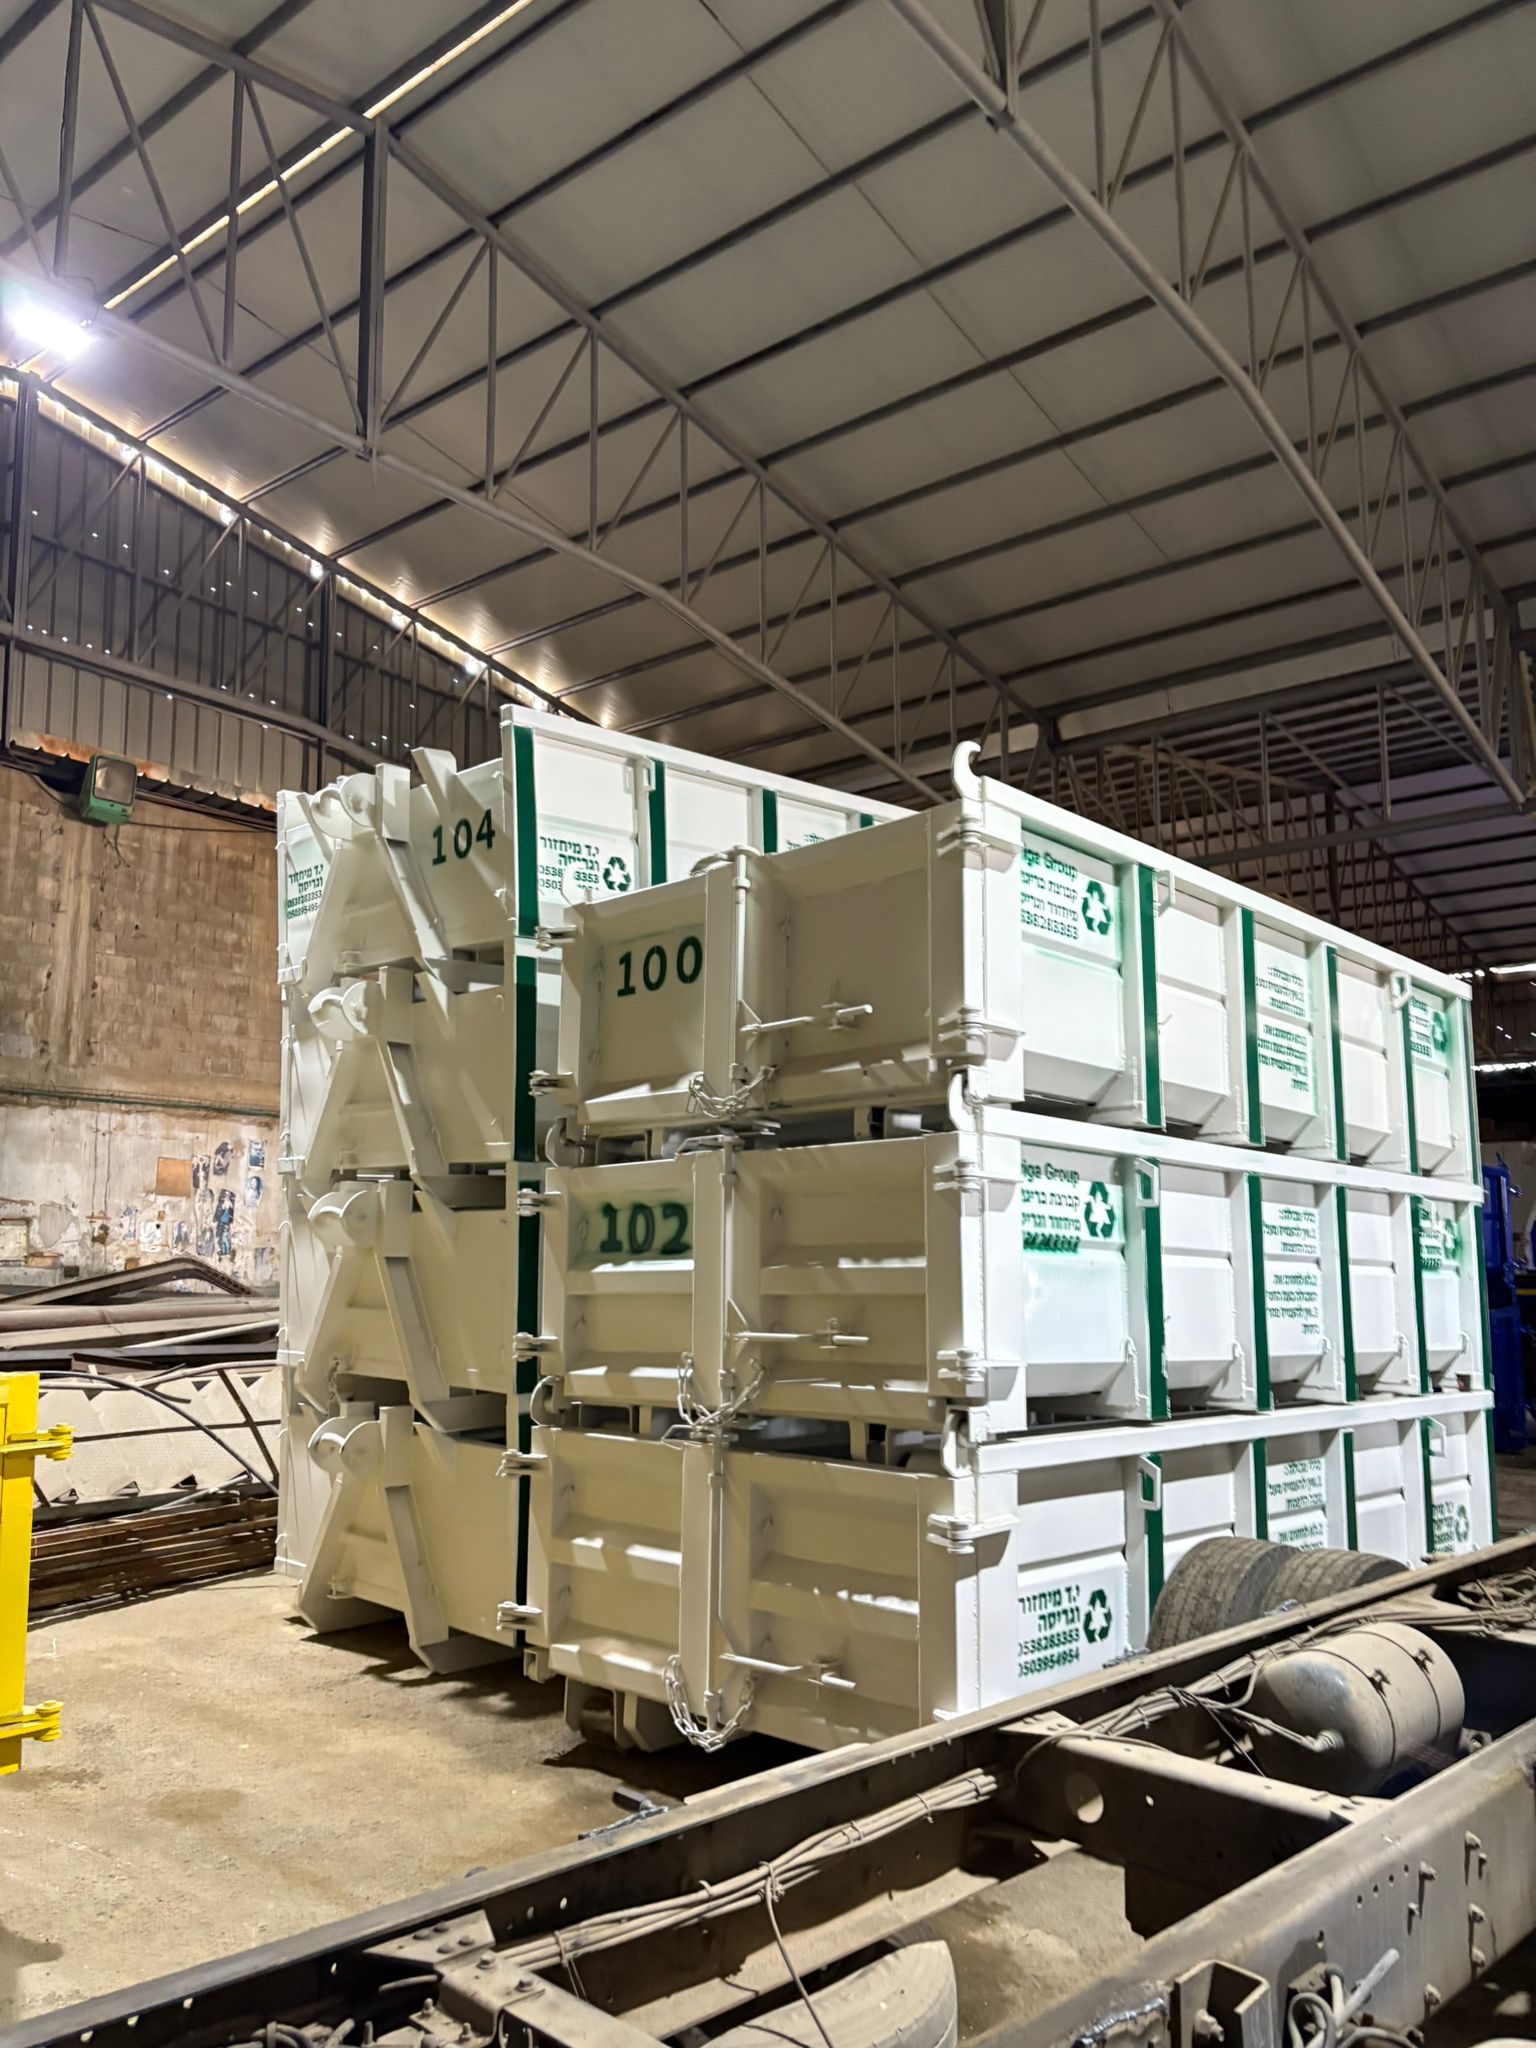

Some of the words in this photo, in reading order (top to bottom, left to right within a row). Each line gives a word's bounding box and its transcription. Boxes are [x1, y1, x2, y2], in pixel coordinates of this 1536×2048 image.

[432, 808, 495, 866] 104
[540, 836, 582, 855] מיחזור
[539, 864, 600, 884] 05383353
[617, 936, 703, 997] 100
[1045, 1162, 1080, 1188] Group
[600, 1202, 693, 1255] 102
[1018, 1588, 1062, 1614] מיחזור
[1038, 1606, 1080, 1633] וגריסה
